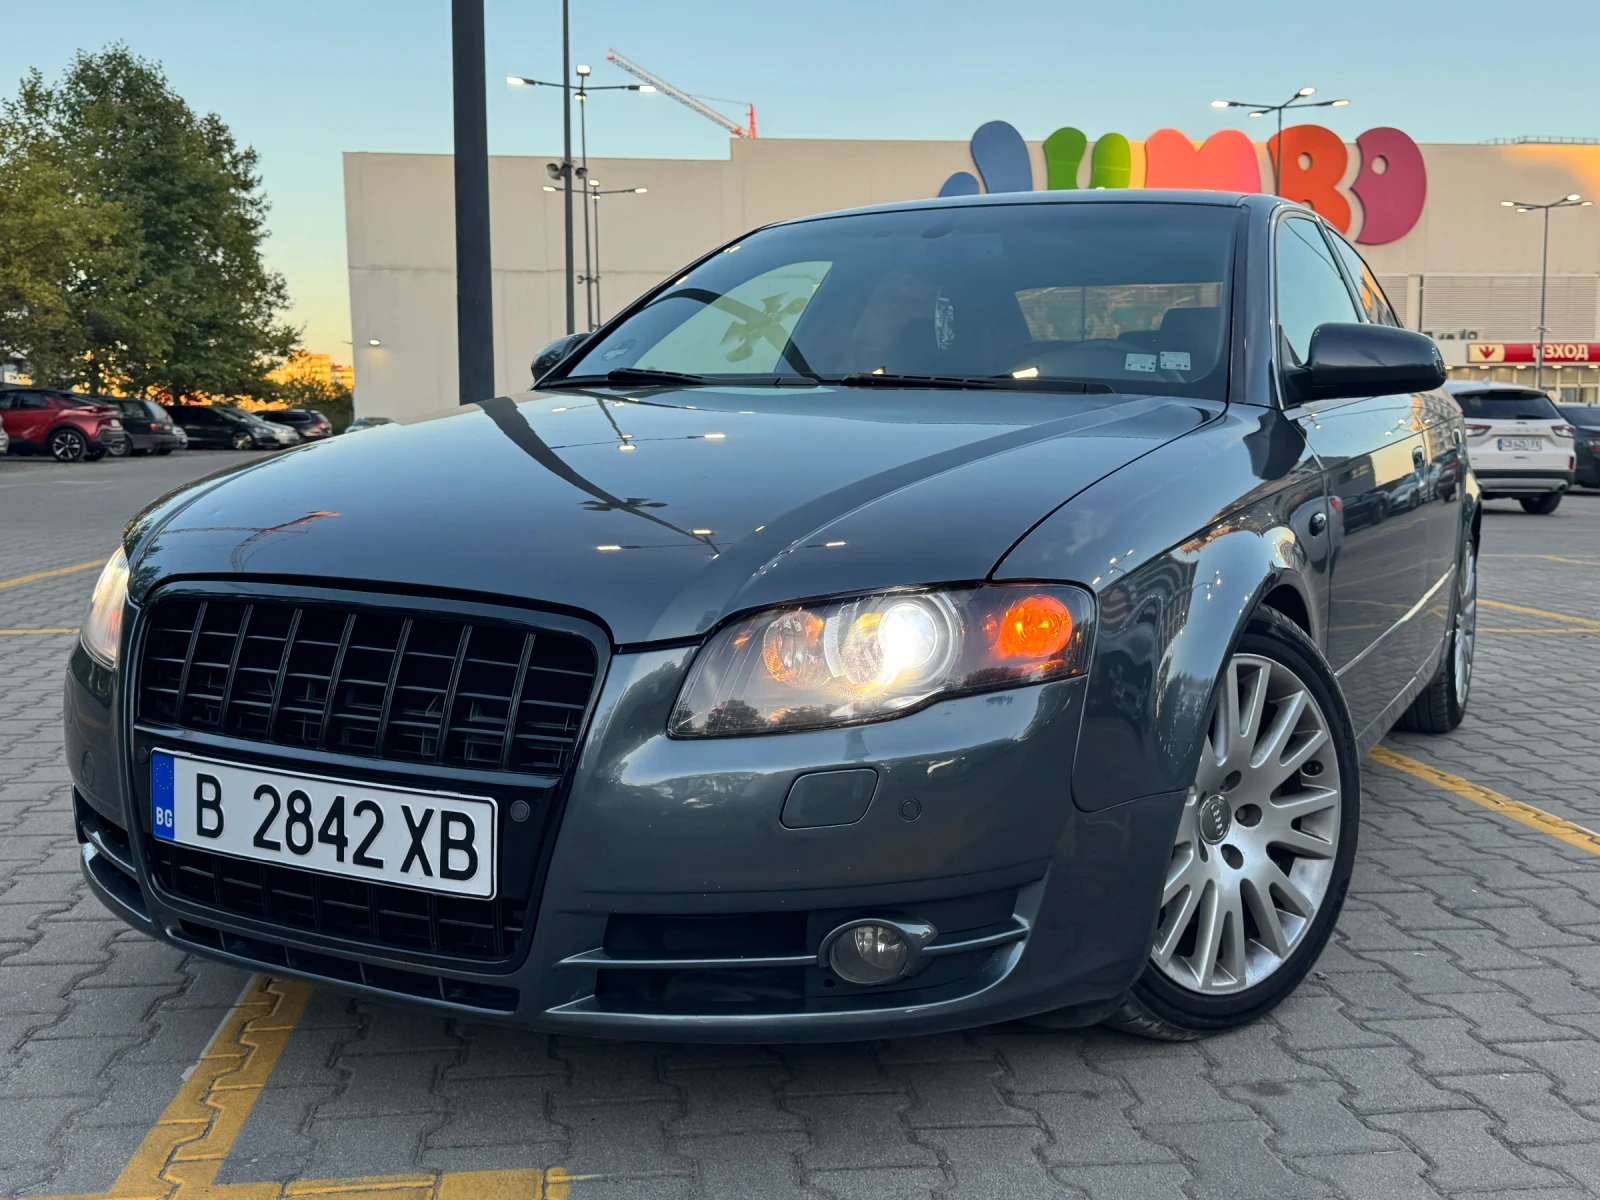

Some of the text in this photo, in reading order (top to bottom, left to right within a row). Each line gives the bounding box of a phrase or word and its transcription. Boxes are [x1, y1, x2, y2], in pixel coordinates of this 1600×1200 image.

[938, 120, 1427, 245] JUMBO
[155, 806, 173, 828] BG
[196, 773, 478, 881] B 2842 XB
